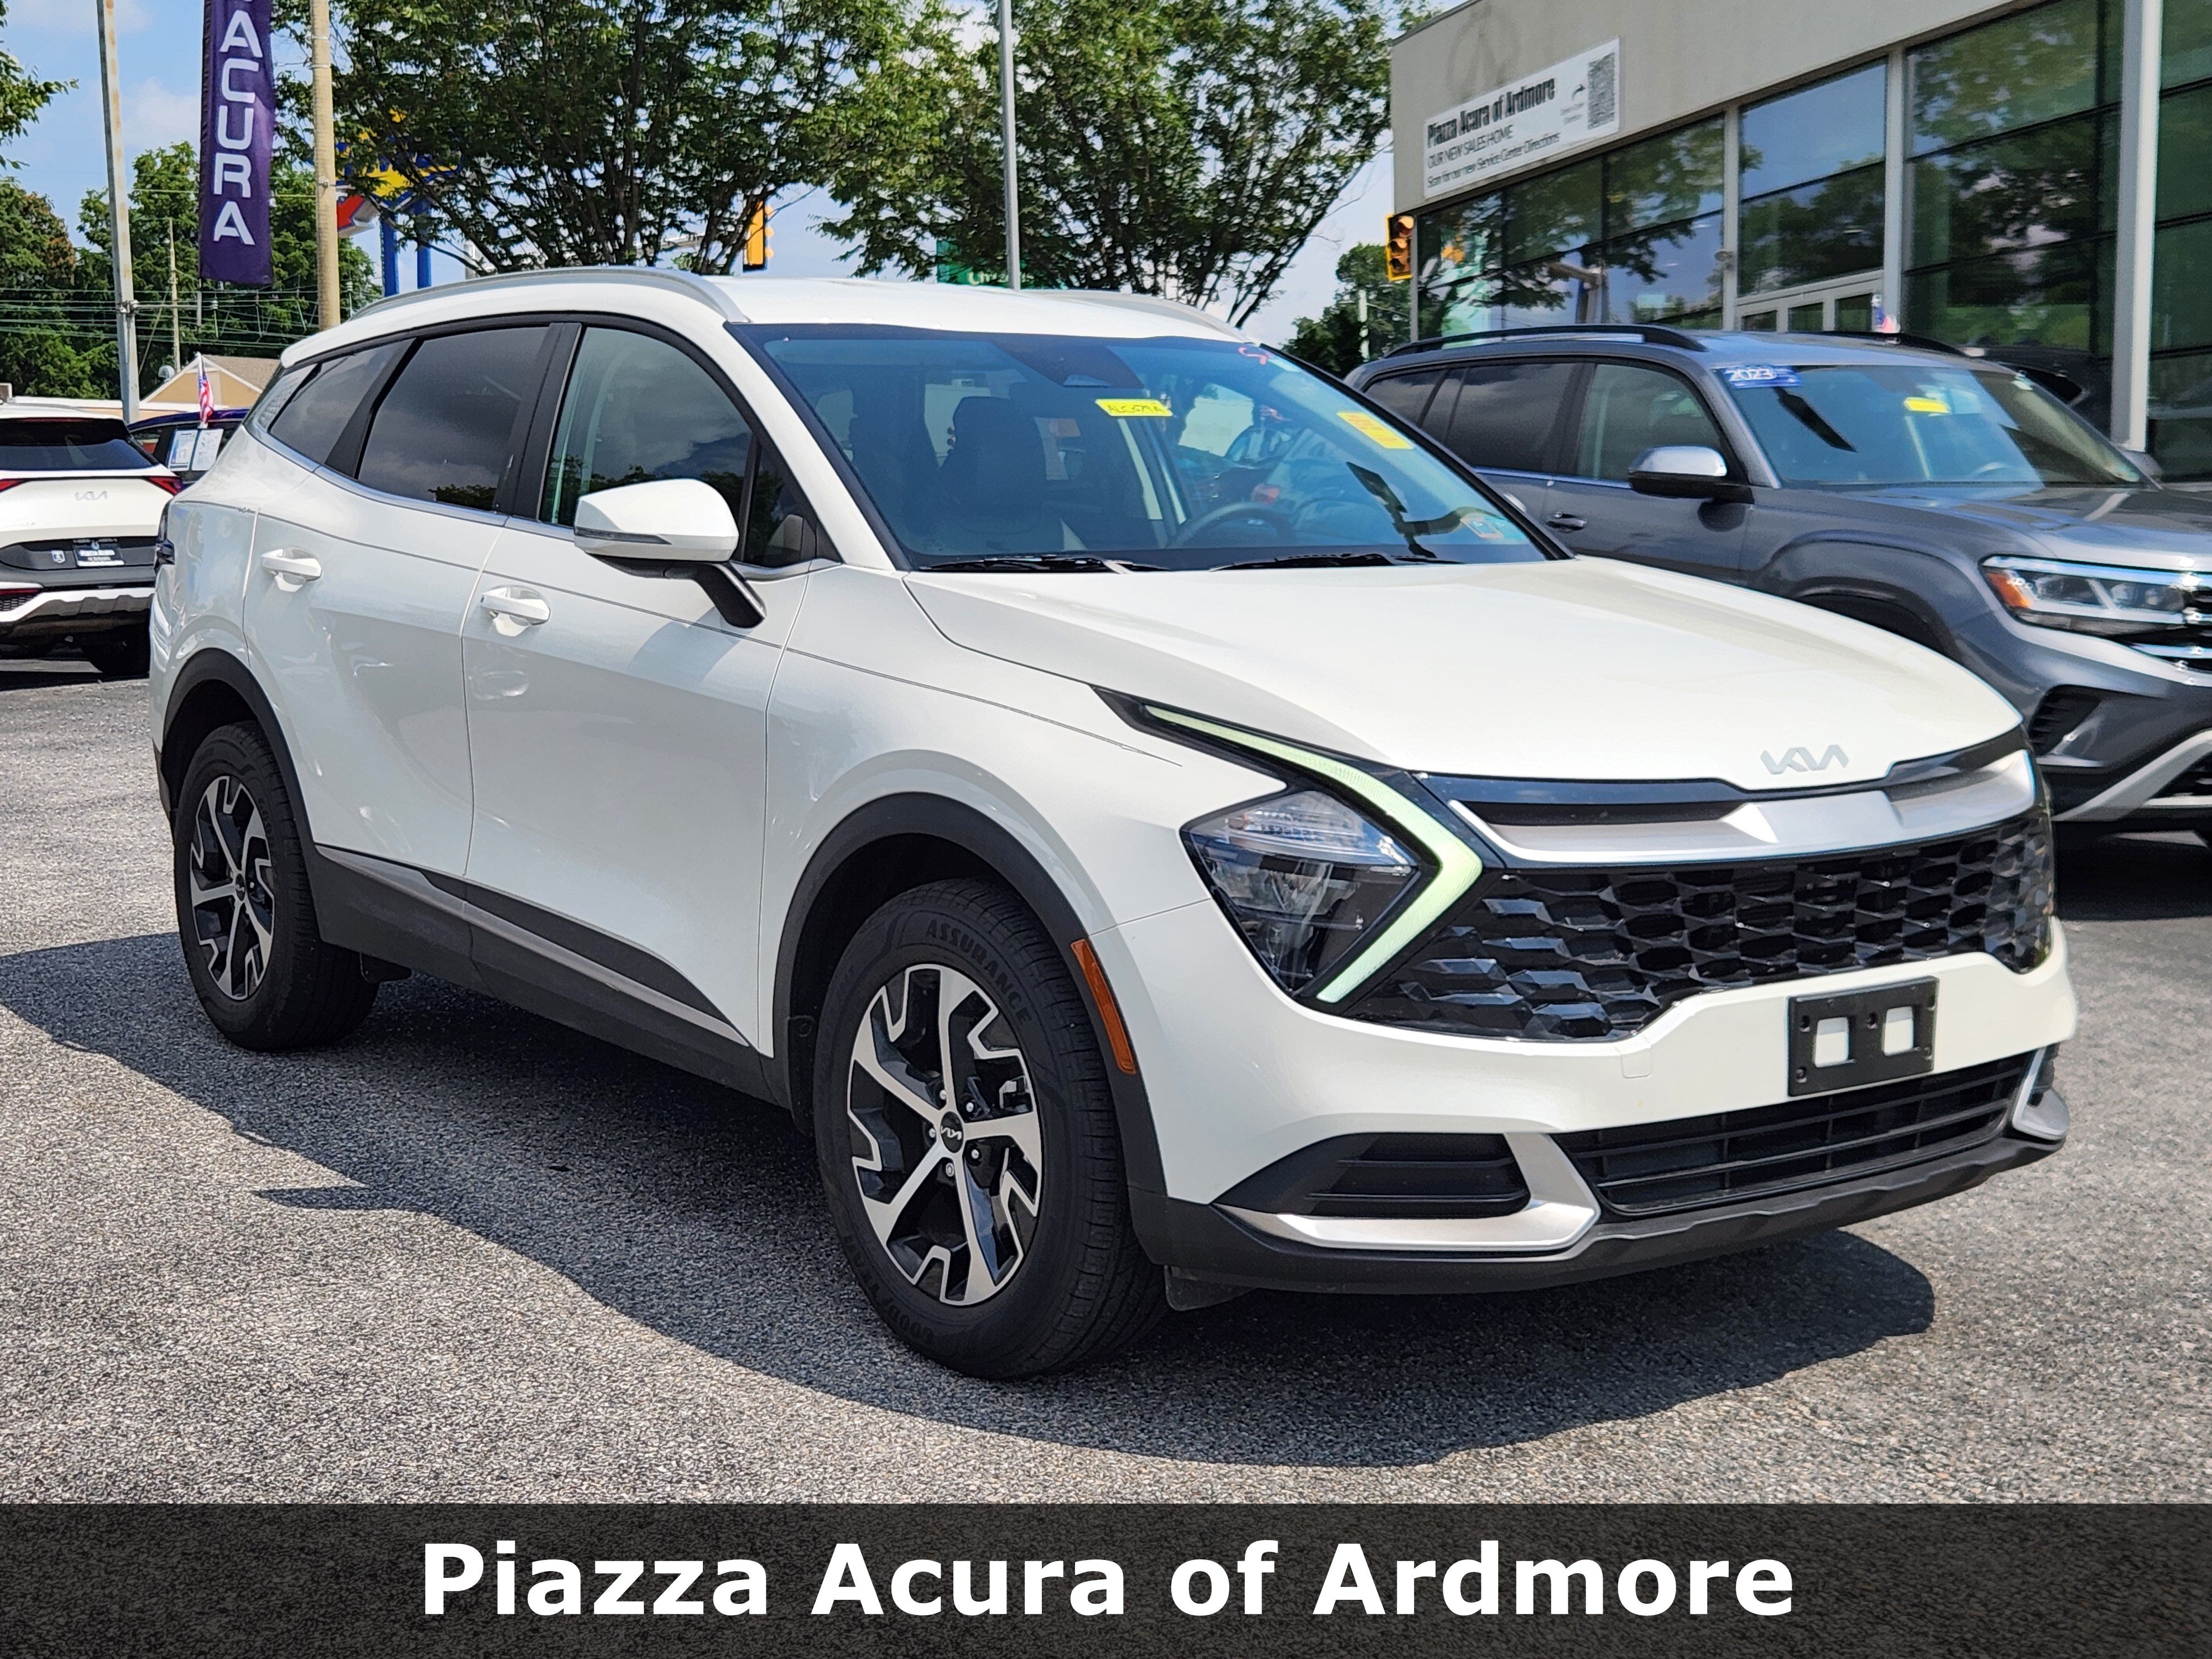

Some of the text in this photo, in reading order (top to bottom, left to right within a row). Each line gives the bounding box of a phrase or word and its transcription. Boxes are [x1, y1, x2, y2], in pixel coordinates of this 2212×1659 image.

[212, 9, 263, 246] ACURA
[1427, 118, 1457, 148] Piazza
[1459, 105, 1490, 136] Acura
[1492, 94, 1504, 123] of
[1505, 77, 1556, 118] Ardmore
[1724, 367, 1777, 382] 2023
[1760, 744, 1849, 775] KIA
[925, 919, 1034, 1026] ASSURANCE
